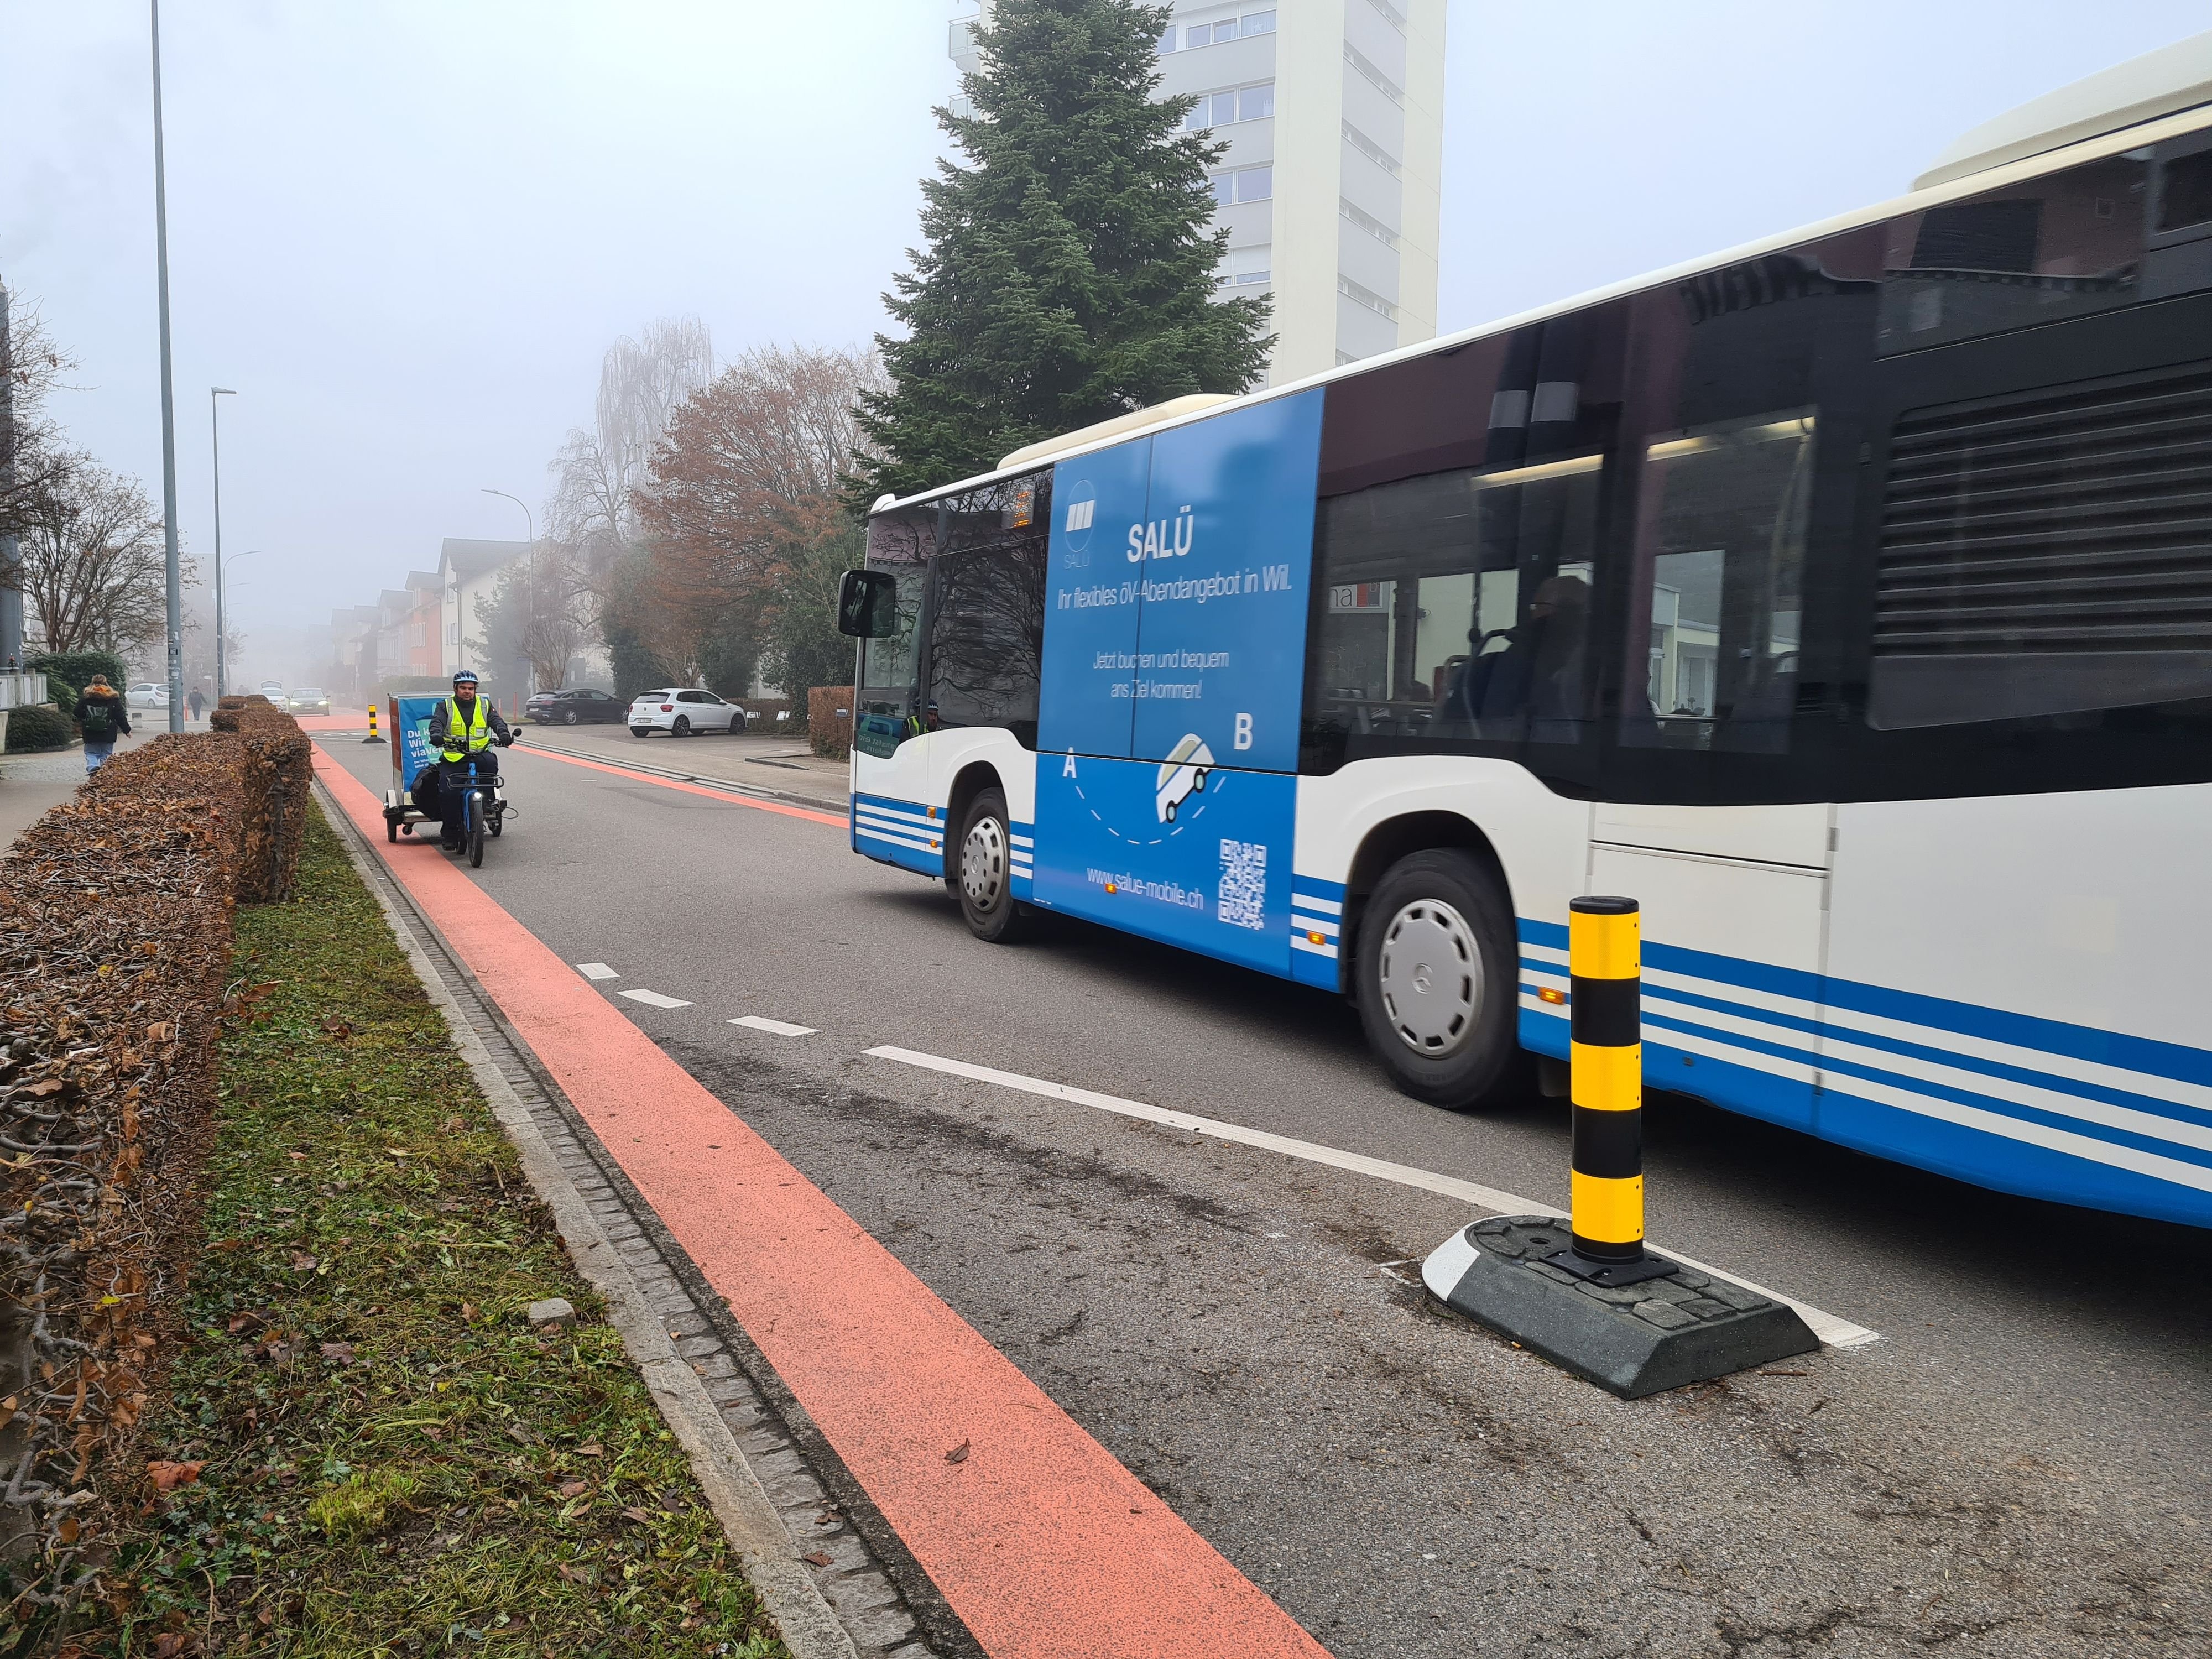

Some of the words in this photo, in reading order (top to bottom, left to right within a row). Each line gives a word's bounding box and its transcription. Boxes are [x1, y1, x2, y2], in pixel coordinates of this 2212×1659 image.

[1126, 505, 1194, 563] SALÜ
[1057, 589, 1072, 609] Ihr
[1073, 585, 1117, 608] flexibles
[1244, 568, 1258, 593] in
[1093, 651, 1117, 669] Jetzt
[1157, 649, 1180, 668] und
[1181, 649, 1229, 672] bequem
[1111, 684, 1129, 698] ans
[1130, 679, 1149, 698] Ziel
[1151, 680, 1202, 699] kommen!
[407, 730, 421, 738] Du
[409, 738, 426, 748] Wir
[1234, 713, 1253, 750] B
[1063, 747, 1077, 779] A
[1087, 868, 1203, 910] wwwsalue-mobile.ch
